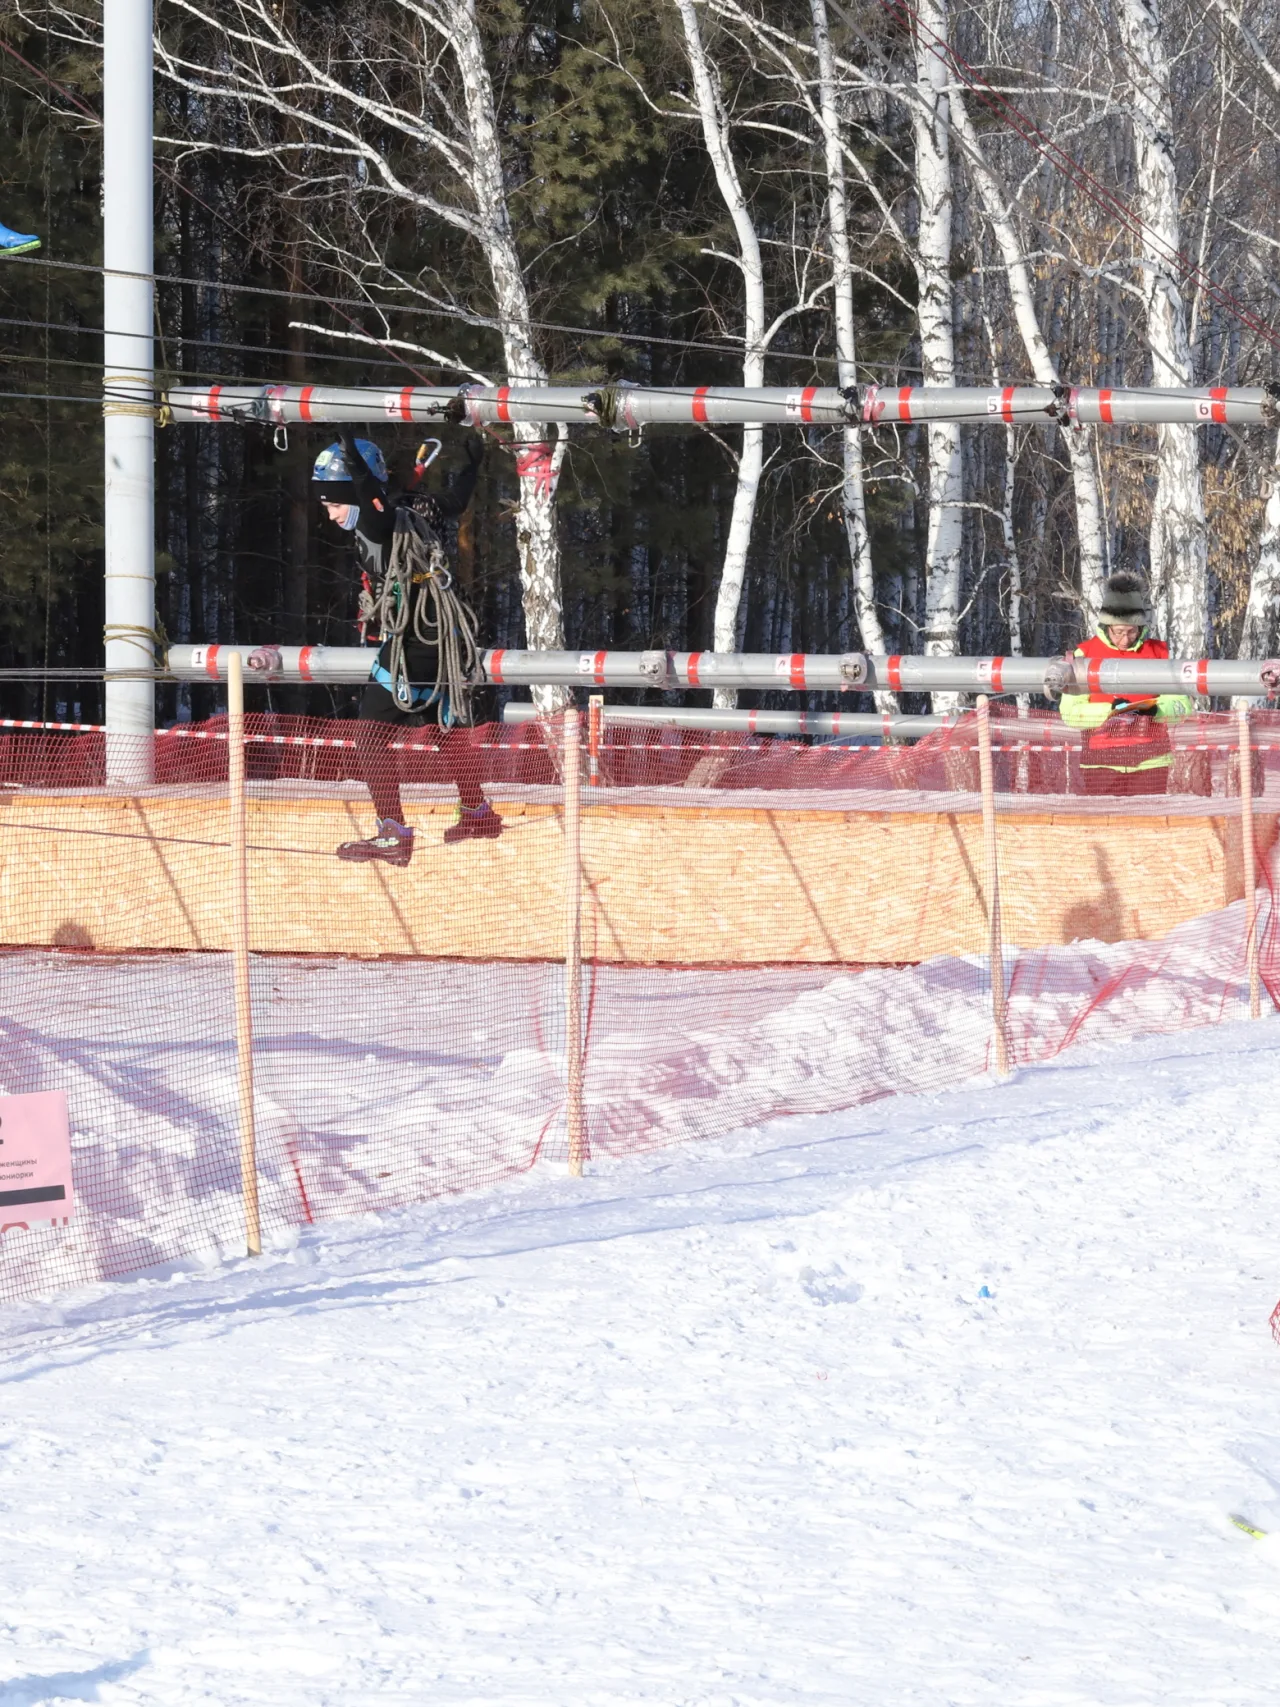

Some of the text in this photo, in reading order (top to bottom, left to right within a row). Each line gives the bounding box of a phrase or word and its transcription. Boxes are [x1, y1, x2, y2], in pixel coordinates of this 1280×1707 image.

[388, 399, 397, 412] 2
[787, 398, 796, 412] 4
[989, 398, 998, 411] 5
[1199, 403, 1209, 415] 6
[195, 651, 203, 664] 1
[582, 658, 591, 672] 3
[979, 664, 988, 677] 5
[1184, 664, 1193, 678] 6
